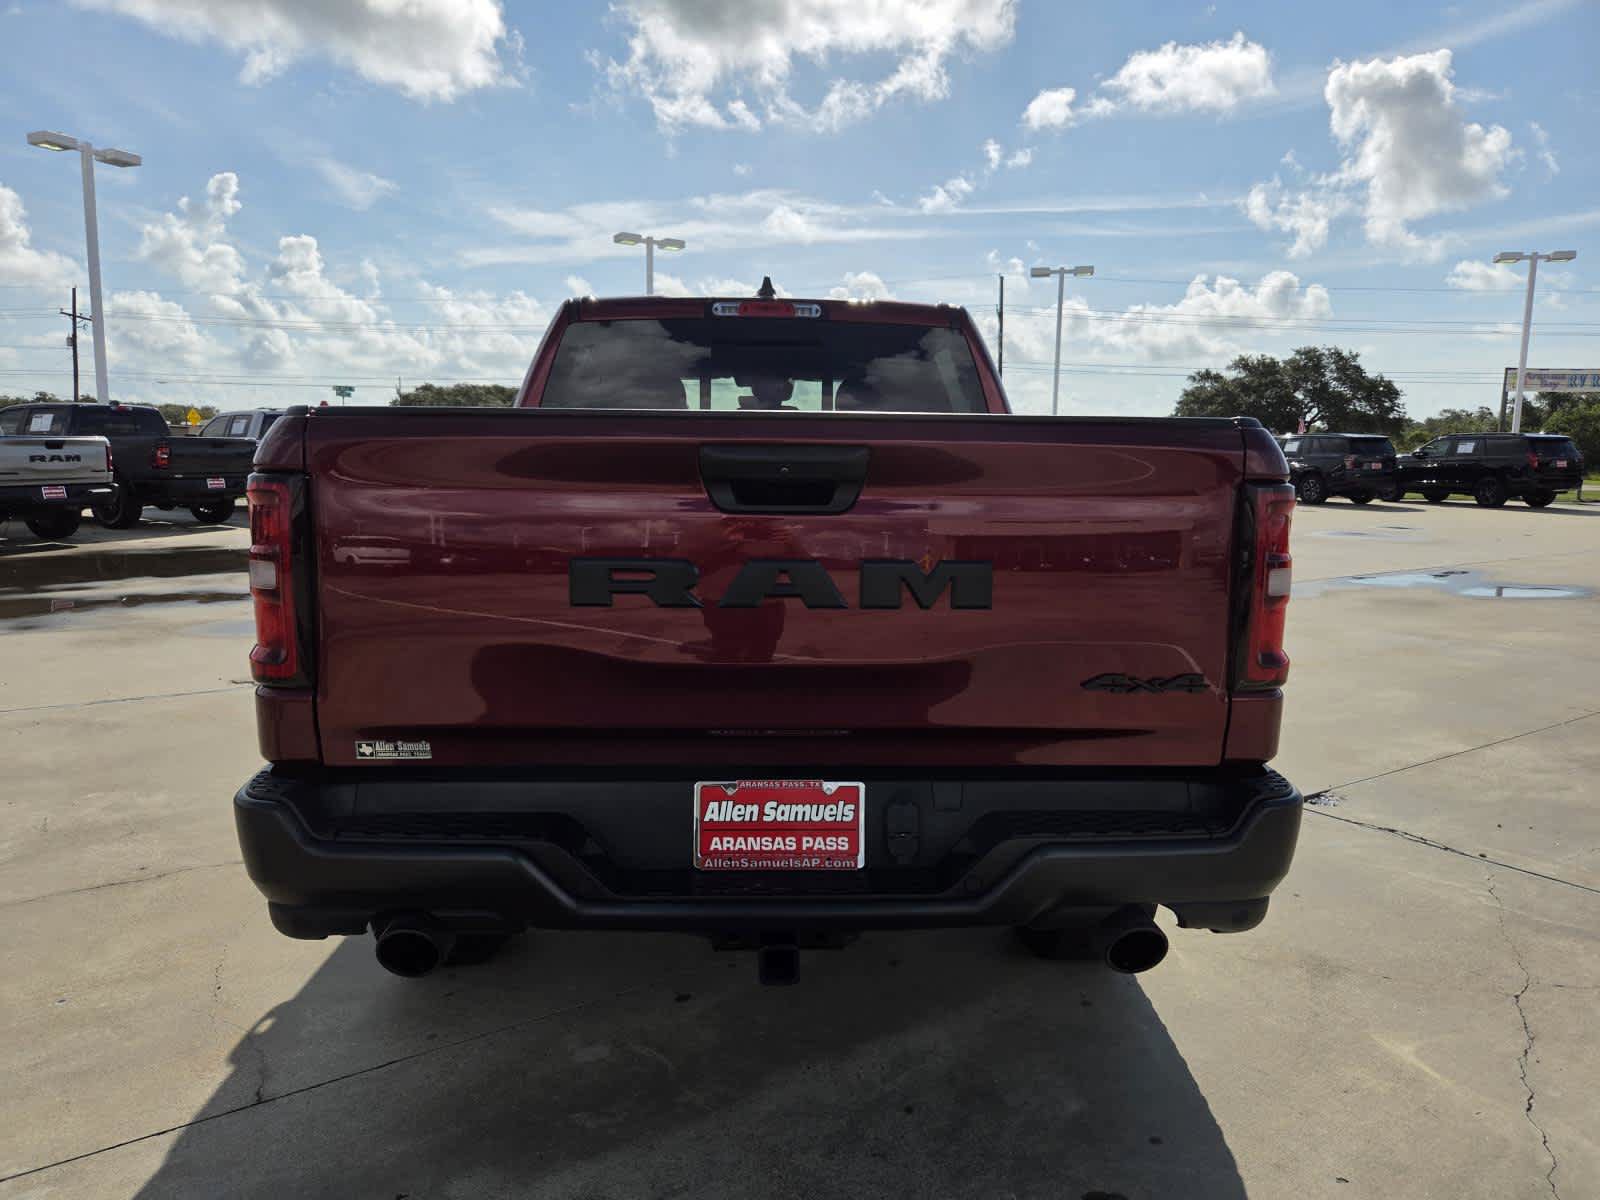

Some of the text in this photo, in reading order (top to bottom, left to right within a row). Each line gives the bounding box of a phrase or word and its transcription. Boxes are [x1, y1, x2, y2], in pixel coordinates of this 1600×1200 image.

[29, 454, 81, 462] RAM
[569, 559, 993, 610] RAM
[375, 740, 431, 751] Allen Samuels
[704, 801, 855, 823] Allen Samuels
[710, 837, 849, 851] ARANSAS PASS
[704, 858, 855, 868] AllenSamuelsAP.com
